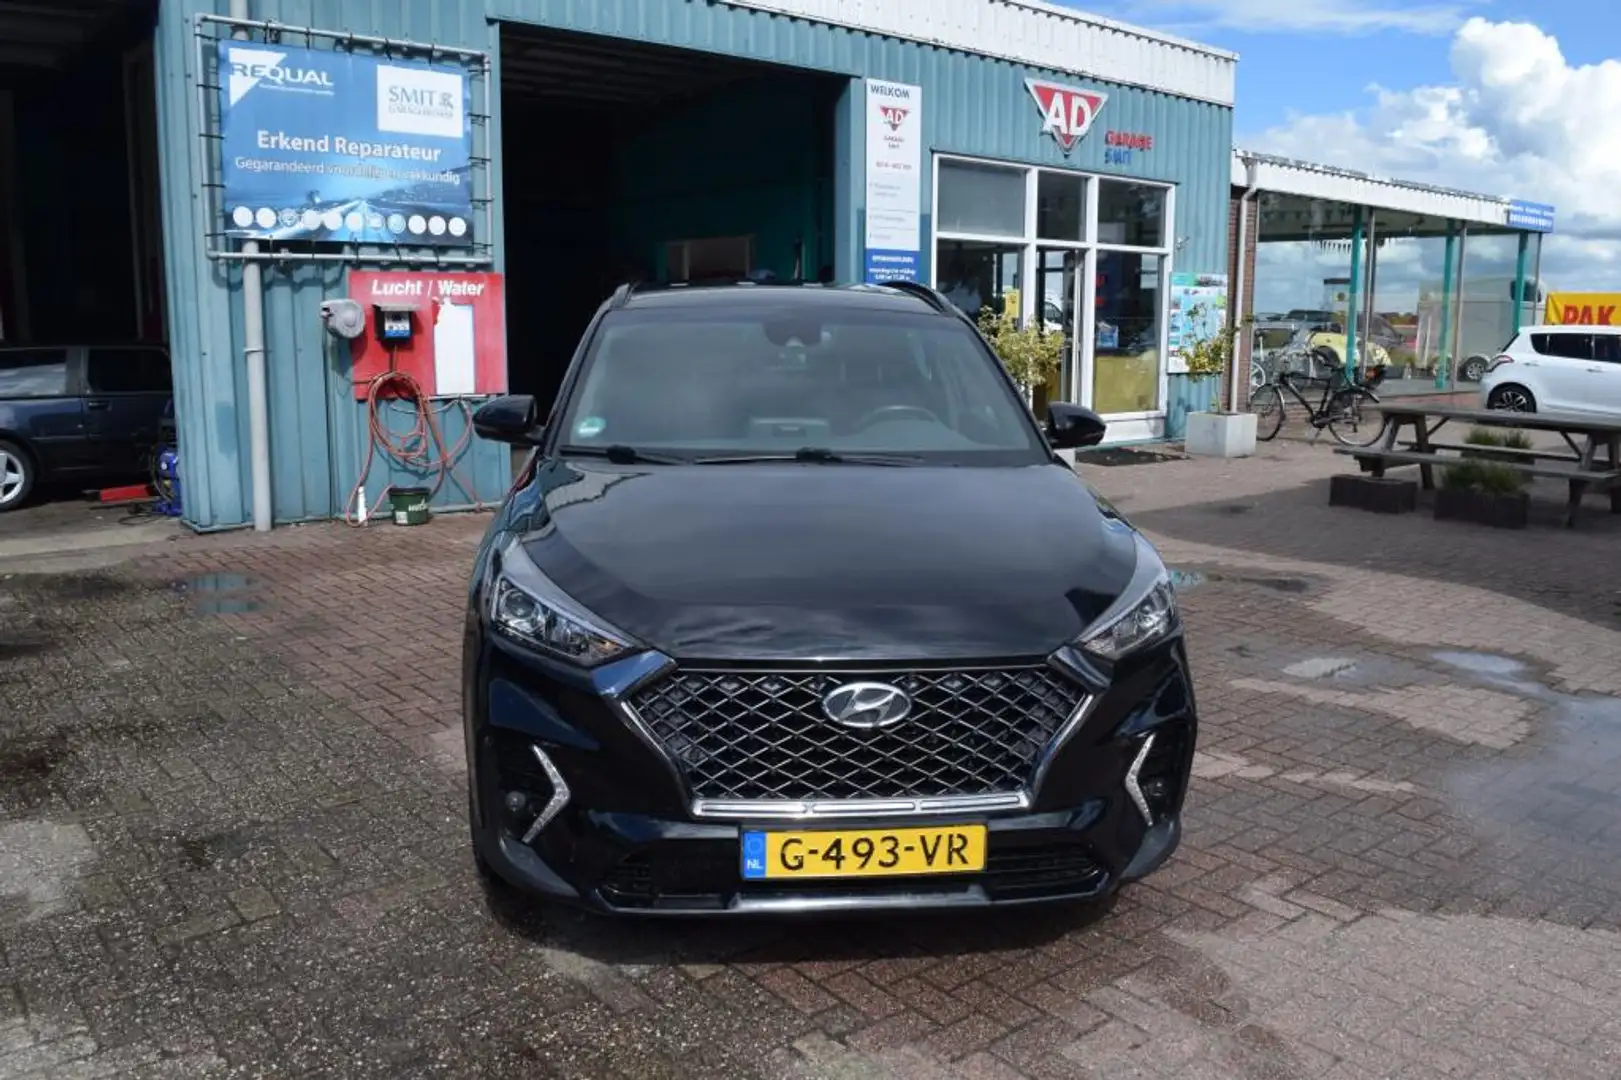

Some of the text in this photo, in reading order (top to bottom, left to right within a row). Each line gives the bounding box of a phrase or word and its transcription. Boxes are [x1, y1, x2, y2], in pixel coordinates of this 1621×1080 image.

[231, 63, 335, 87] REQUAL
[388, 85, 437, 107] SMIT
[870, 84, 910, 99] WELKOM
[885, 108, 905, 125] AD
[1042, 92, 1092, 136] AD
[258, 131, 441, 163] Erkend Reparateur
[235, 156, 325, 174] Gegarandeerd
[371, 279, 485, 297] Lucht / Water
[1562, 303, 1616, 326] PAK
[747, 834, 970, 872] NL G-493-VR
